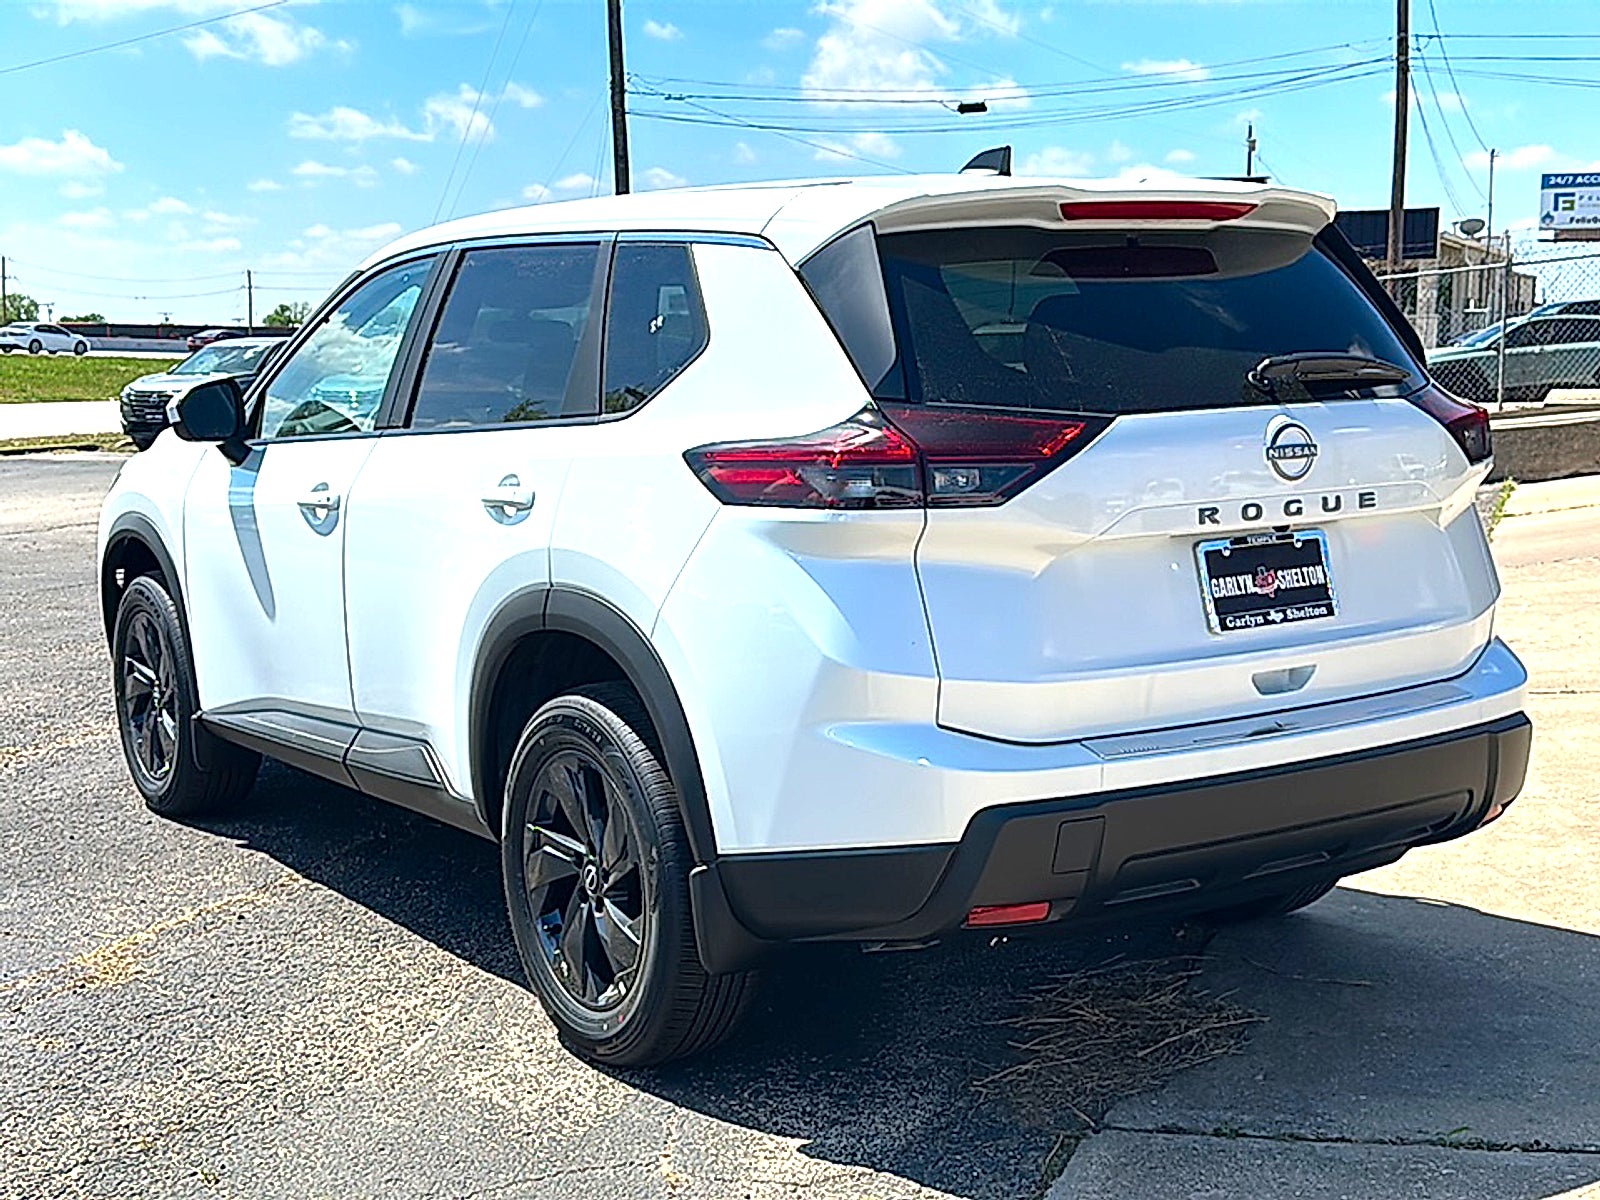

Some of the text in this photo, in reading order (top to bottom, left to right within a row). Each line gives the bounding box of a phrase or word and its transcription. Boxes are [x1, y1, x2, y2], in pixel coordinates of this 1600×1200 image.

[1549, 175, 1600, 185] 24/7 ACC
[1268, 446, 1317, 459] NISSAN
[1198, 492, 1377, 525] ROGUE
[1211, 565, 1326, 598] GARLYN SHELTON
[1226, 606, 1328, 628] Garlyn Shelton
